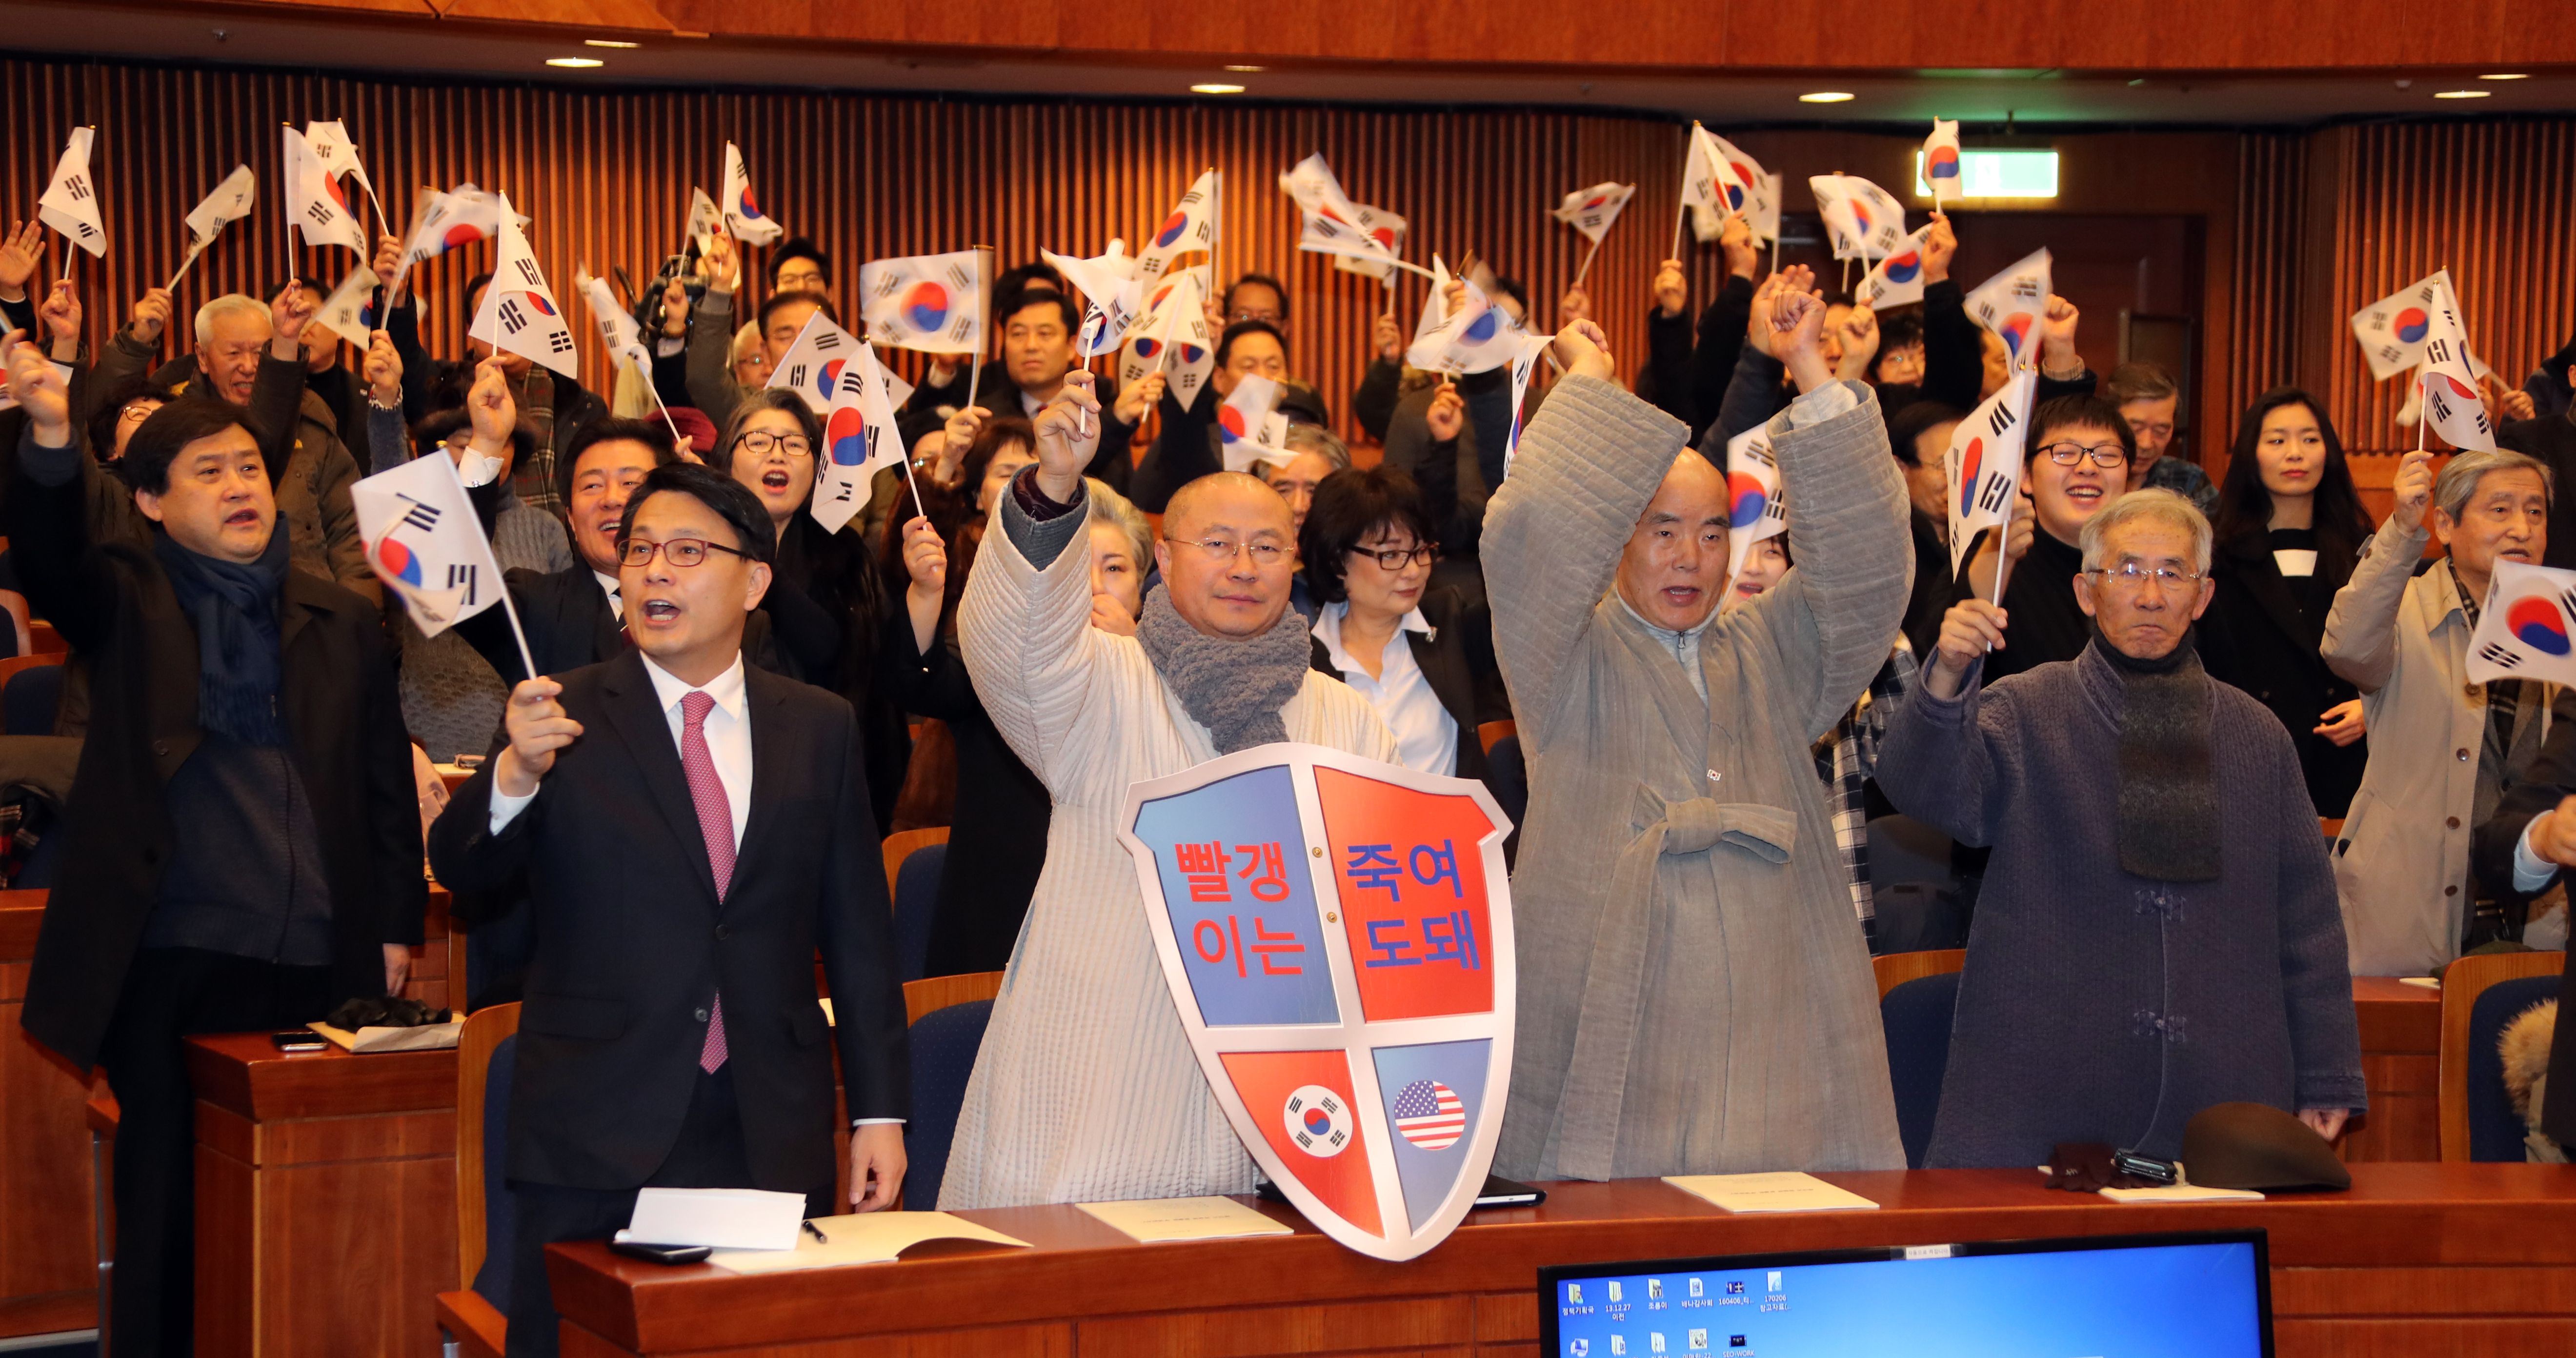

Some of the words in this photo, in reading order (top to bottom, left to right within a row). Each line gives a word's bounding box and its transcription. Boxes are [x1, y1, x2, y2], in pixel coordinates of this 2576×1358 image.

[1175, 840, 1290, 902] 빨갱
[1347, 839, 1463, 902] 죽여
[1193, 915, 1305, 978] 이는
[1366, 910, 1480, 970] 도돼
[1605, 1303, 1631, 1312] 13.12.27
[1765, 1294, 1787, 1302] 170206
